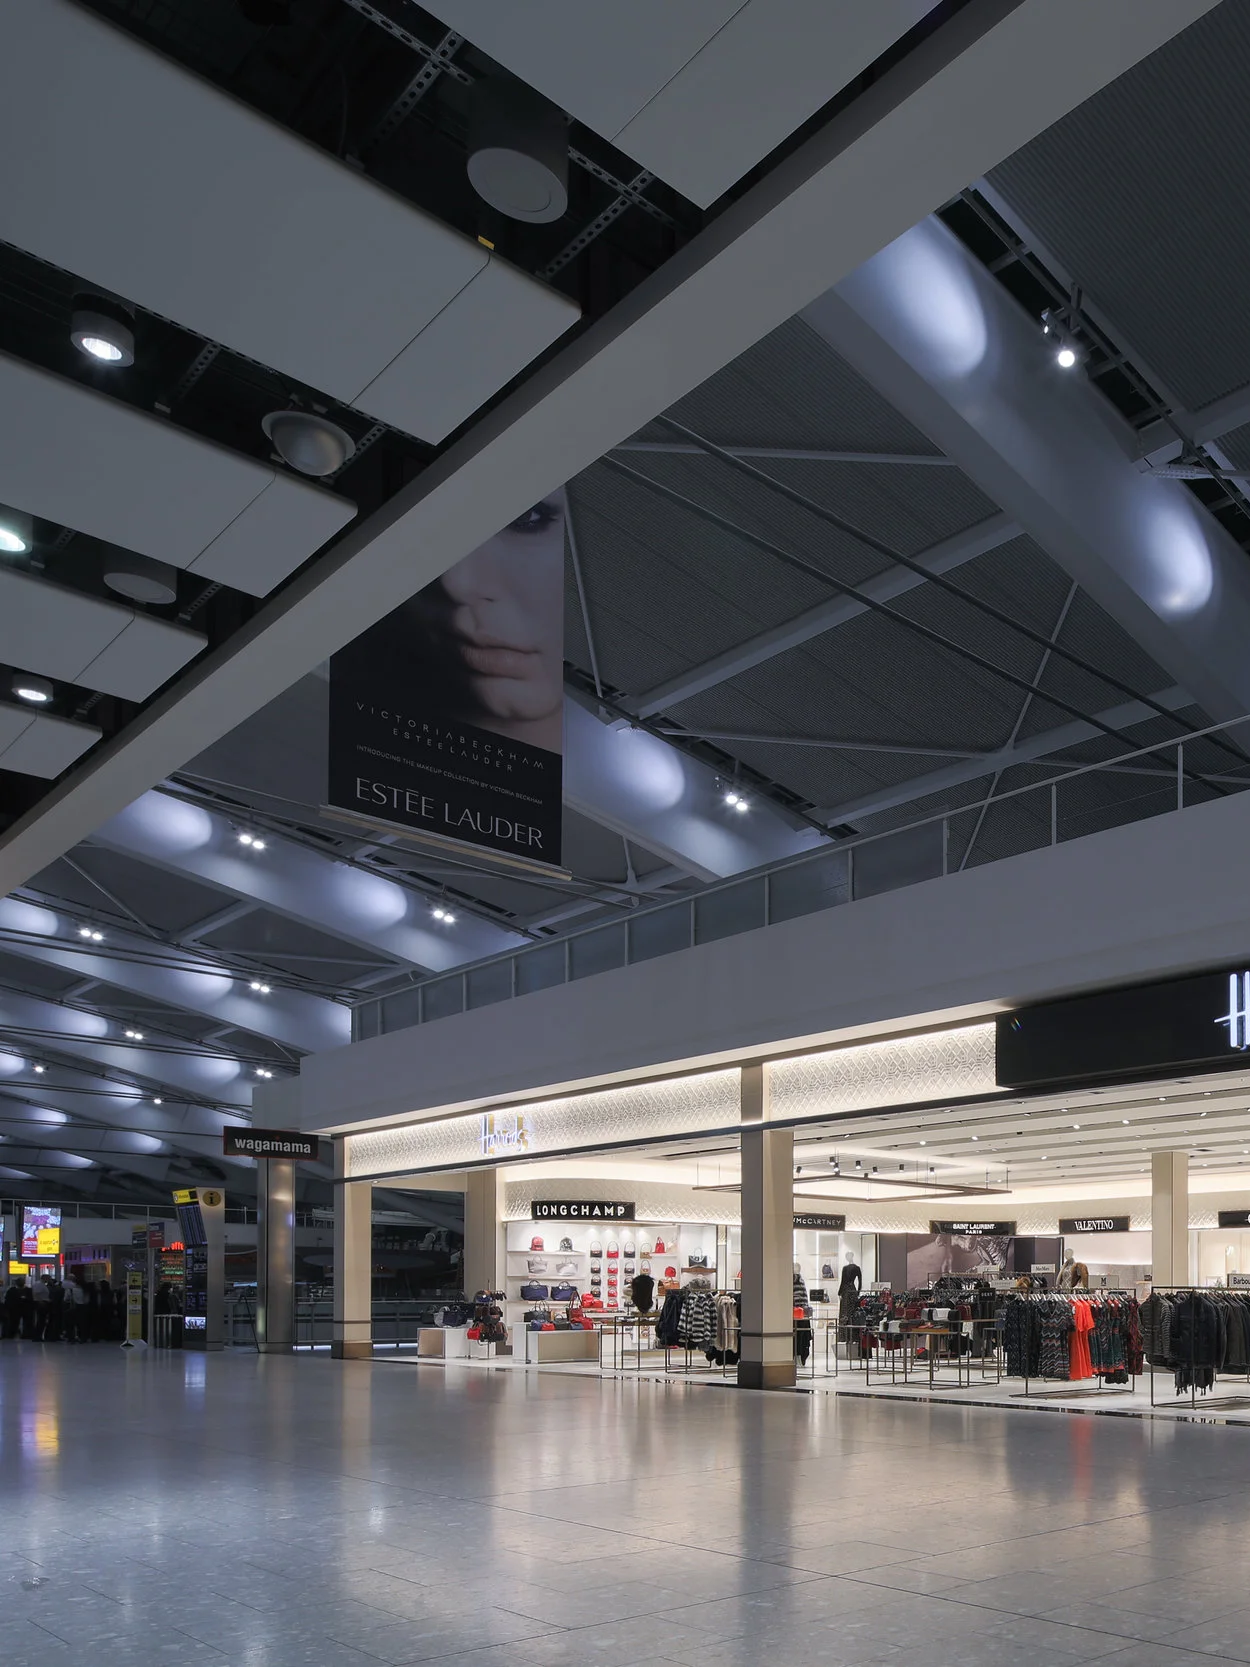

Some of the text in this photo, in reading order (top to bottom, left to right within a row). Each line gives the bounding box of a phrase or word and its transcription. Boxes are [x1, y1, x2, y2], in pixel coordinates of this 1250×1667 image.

[356, 744, 401, 762] INTRODUCING
[403, 758, 415, 767] THE
[416, 763, 442, 774] MAKEUP
[443, 770, 480, 786] COLLECTION
[489, 783, 515, 797] VICTORIA
[516, 792, 543, 805] BECKHAM
[444, 803, 543, 849] LAUDER
[234, 1138, 312, 1154] wagamama
[477, 1113, 529, 1156] Harrods
[536, 1205, 625, 1216] LONGCHAMP
[1074, 1219, 1114, 1231] VALENTINO
